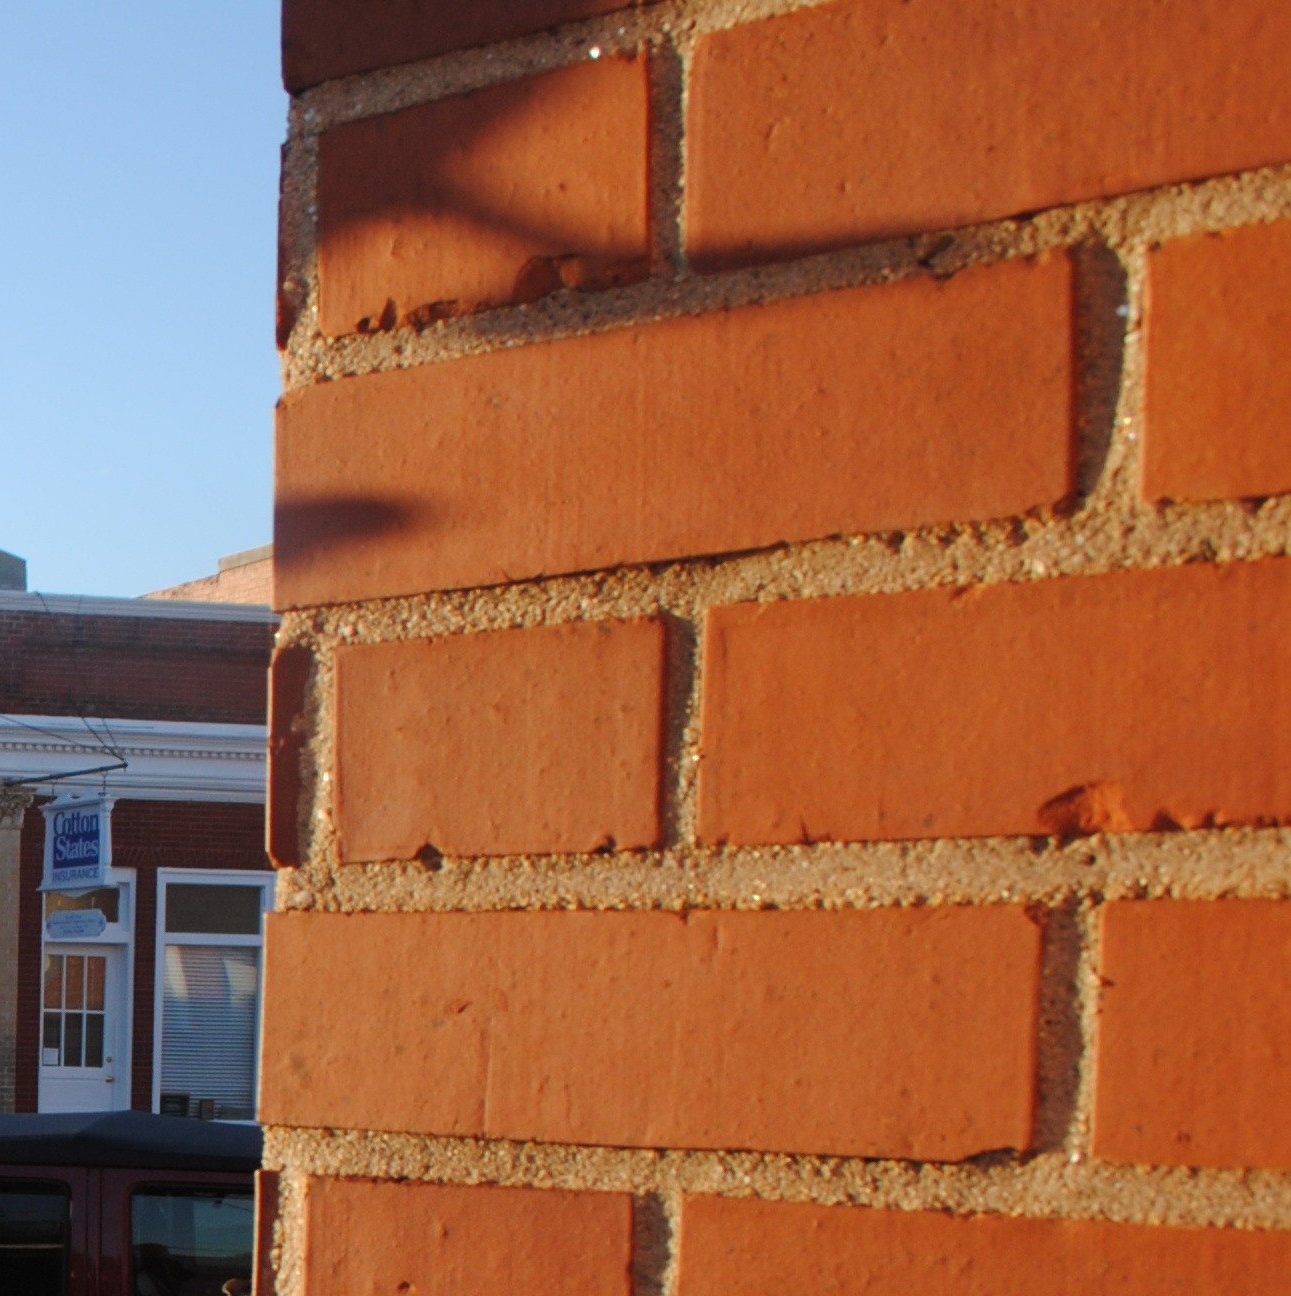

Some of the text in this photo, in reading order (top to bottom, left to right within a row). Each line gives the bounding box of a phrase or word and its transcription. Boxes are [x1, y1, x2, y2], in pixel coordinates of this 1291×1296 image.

[53, 811, 99, 836] Cotton
[56, 836, 99, 861] States
[53, 867, 99, 881] INSURANCE
